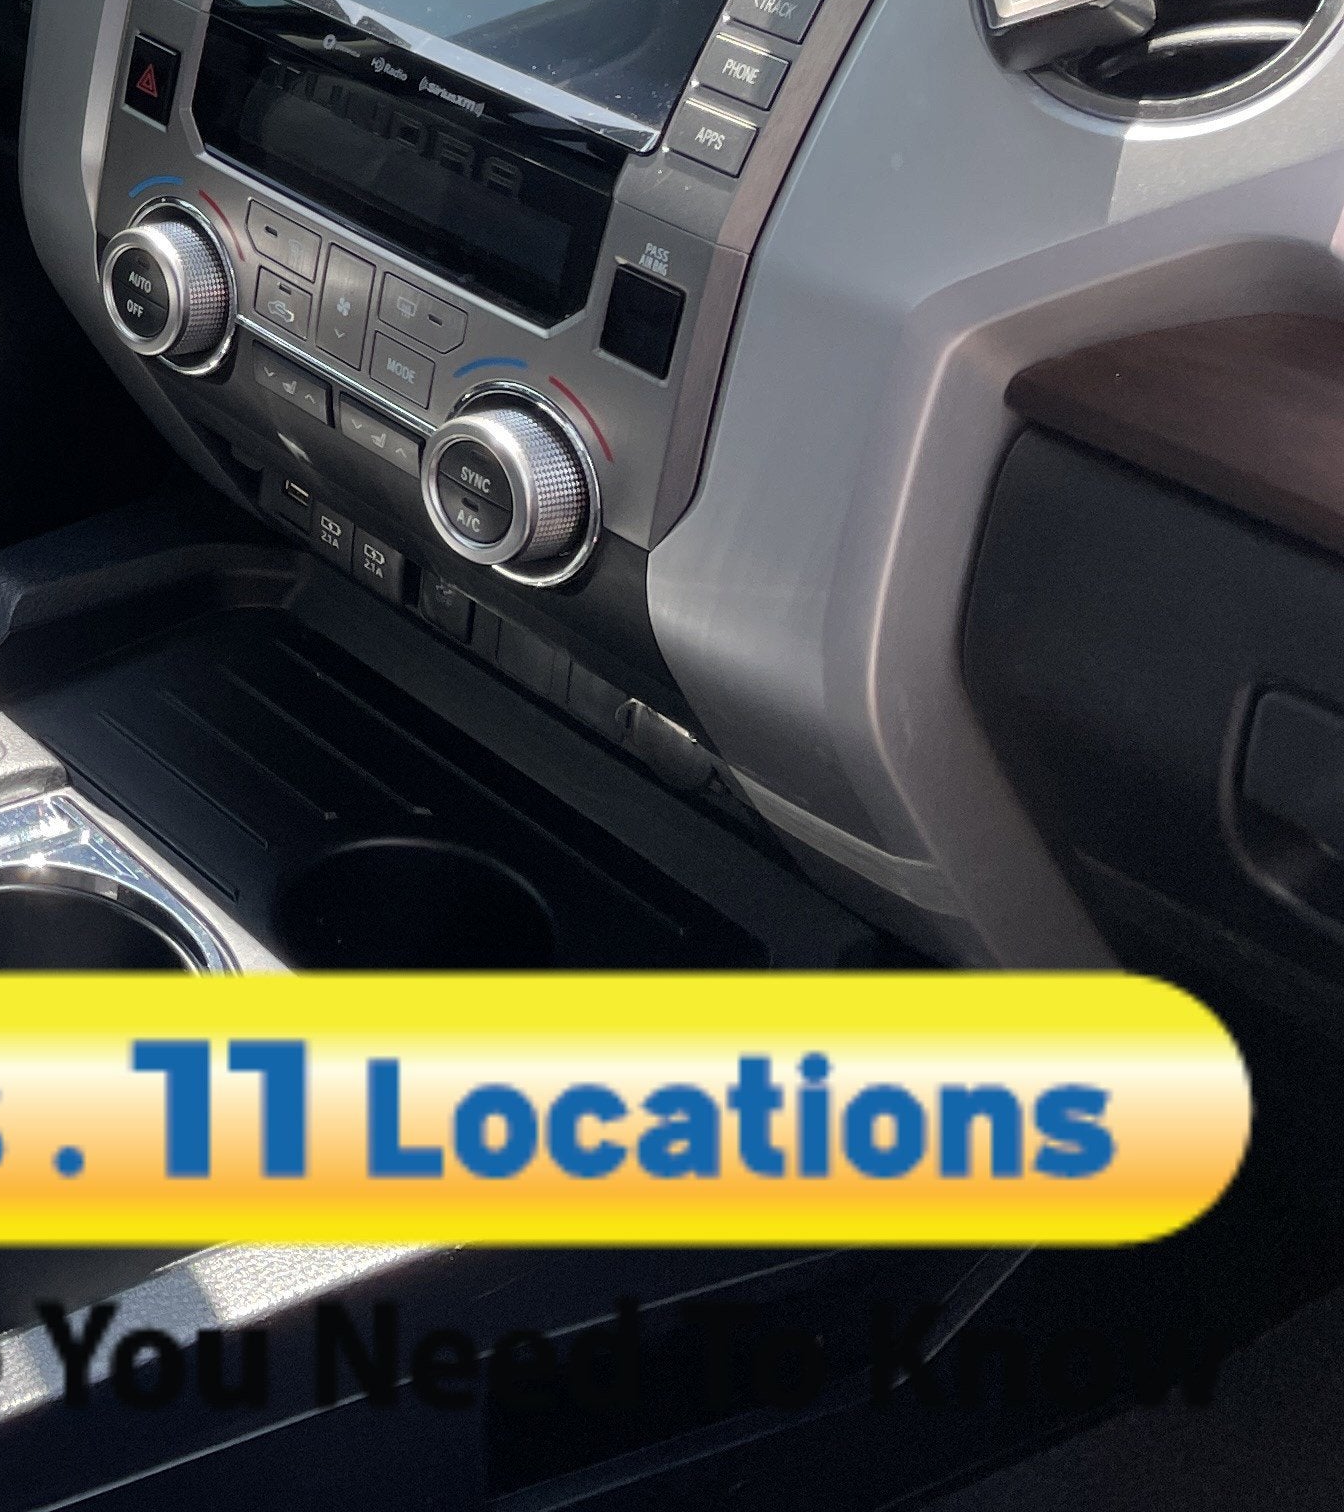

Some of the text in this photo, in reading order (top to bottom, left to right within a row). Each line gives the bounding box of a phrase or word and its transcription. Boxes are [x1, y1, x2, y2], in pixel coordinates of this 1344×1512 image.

[721, 58, 760, 85] PHONE
[694, 126, 726, 151] APPS
[644, 242, 670, 263] PASS
[128, 271, 152, 294] AUTO
[126, 299, 144, 318] OFF
[386, 357, 416, 384] MODE
[460, 466, 491, 493] SYNC
[456, 509, 481, 533] A/C
